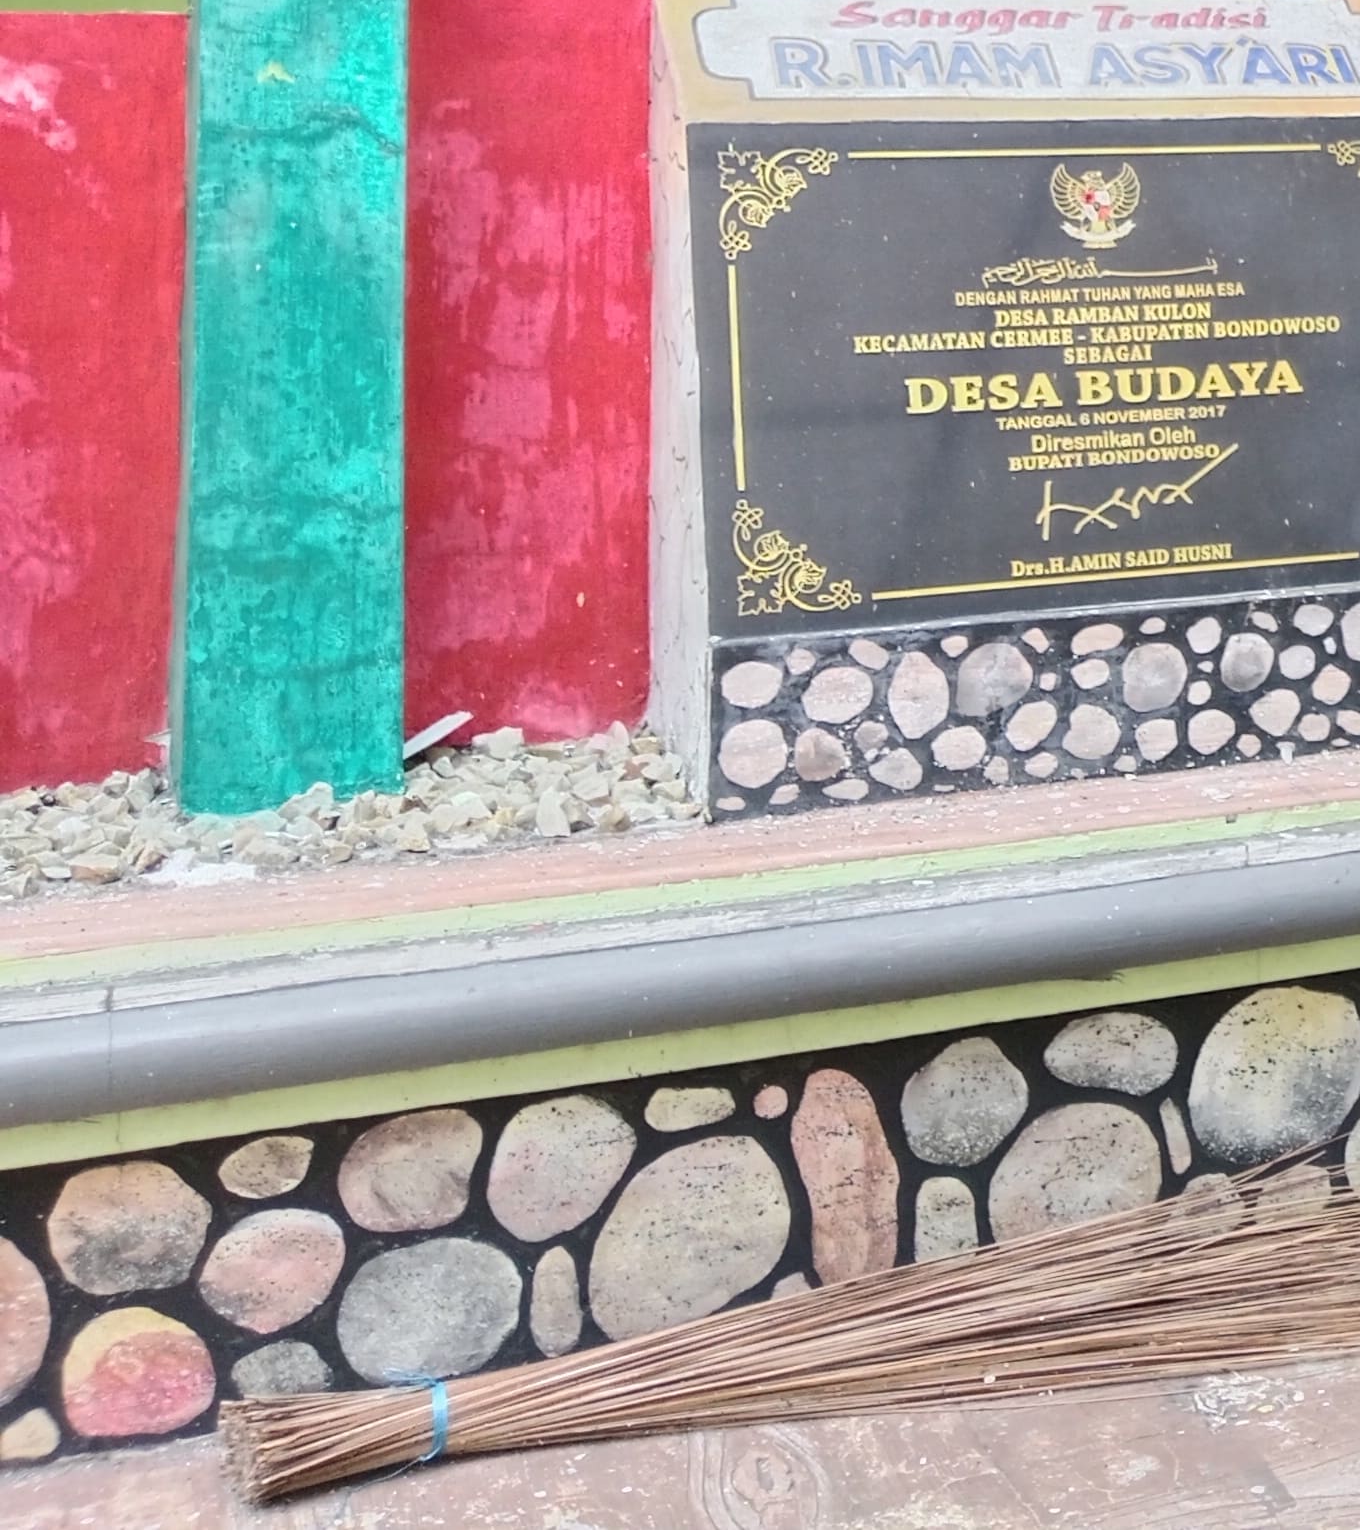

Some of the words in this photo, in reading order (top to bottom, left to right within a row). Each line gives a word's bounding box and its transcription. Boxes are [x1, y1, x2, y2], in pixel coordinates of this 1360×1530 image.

[830, 0, 1084, 36] Sanggar
[1092, 4, 1270, 32] Tradisi
[955, 290, 1017, 307] DENGAN
[1020, 288, 1079, 305] RAHMAT
[1083, 286, 1130, 303] TUHAN
[1133, 284, 1172, 300] YANG
[1174, 283, 1215, 299] MAHA
[1217, 281, 1246, 297] ESA
[994, 308, 1050, 328] DESA
[1052, 305, 1139, 326] RAMBAN
[1142, 302, 1212, 322] KULON
[853, 331, 986, 354] KECAMATAN
[990, 327, 1074, 349] CERMEE
[1091, 322, 1209, 345] KABUPATEN
[1213, 315, 1341, 339] BONDOWOSO
[1063, 344, 1153, 365] SEBAGAI
[904, 372, 1063, 415] DESA
[1075, 359, 1304, 406] BUDAYA
[995, 414, 1077, 431] TANGGAL
[1080, 412, 1091, 427] 6
[1093, 406, 1185, 426] NOVEMBER
[1188, 404, 1227, 420] 2017
[1031, 430, 1145, 454] Diresmikan
[1150, 425, 1196, 446] Oleh
[1008, 451, 1083, 472] BUPATI
[1088, 443, 1221, 467] BONDOWOSO
[1010, 552, 1122, 577] Drs.H.AMIN
[1124, 548, 1170, 568] SAID
[1173, 543, 1233, 563] HUSNI
